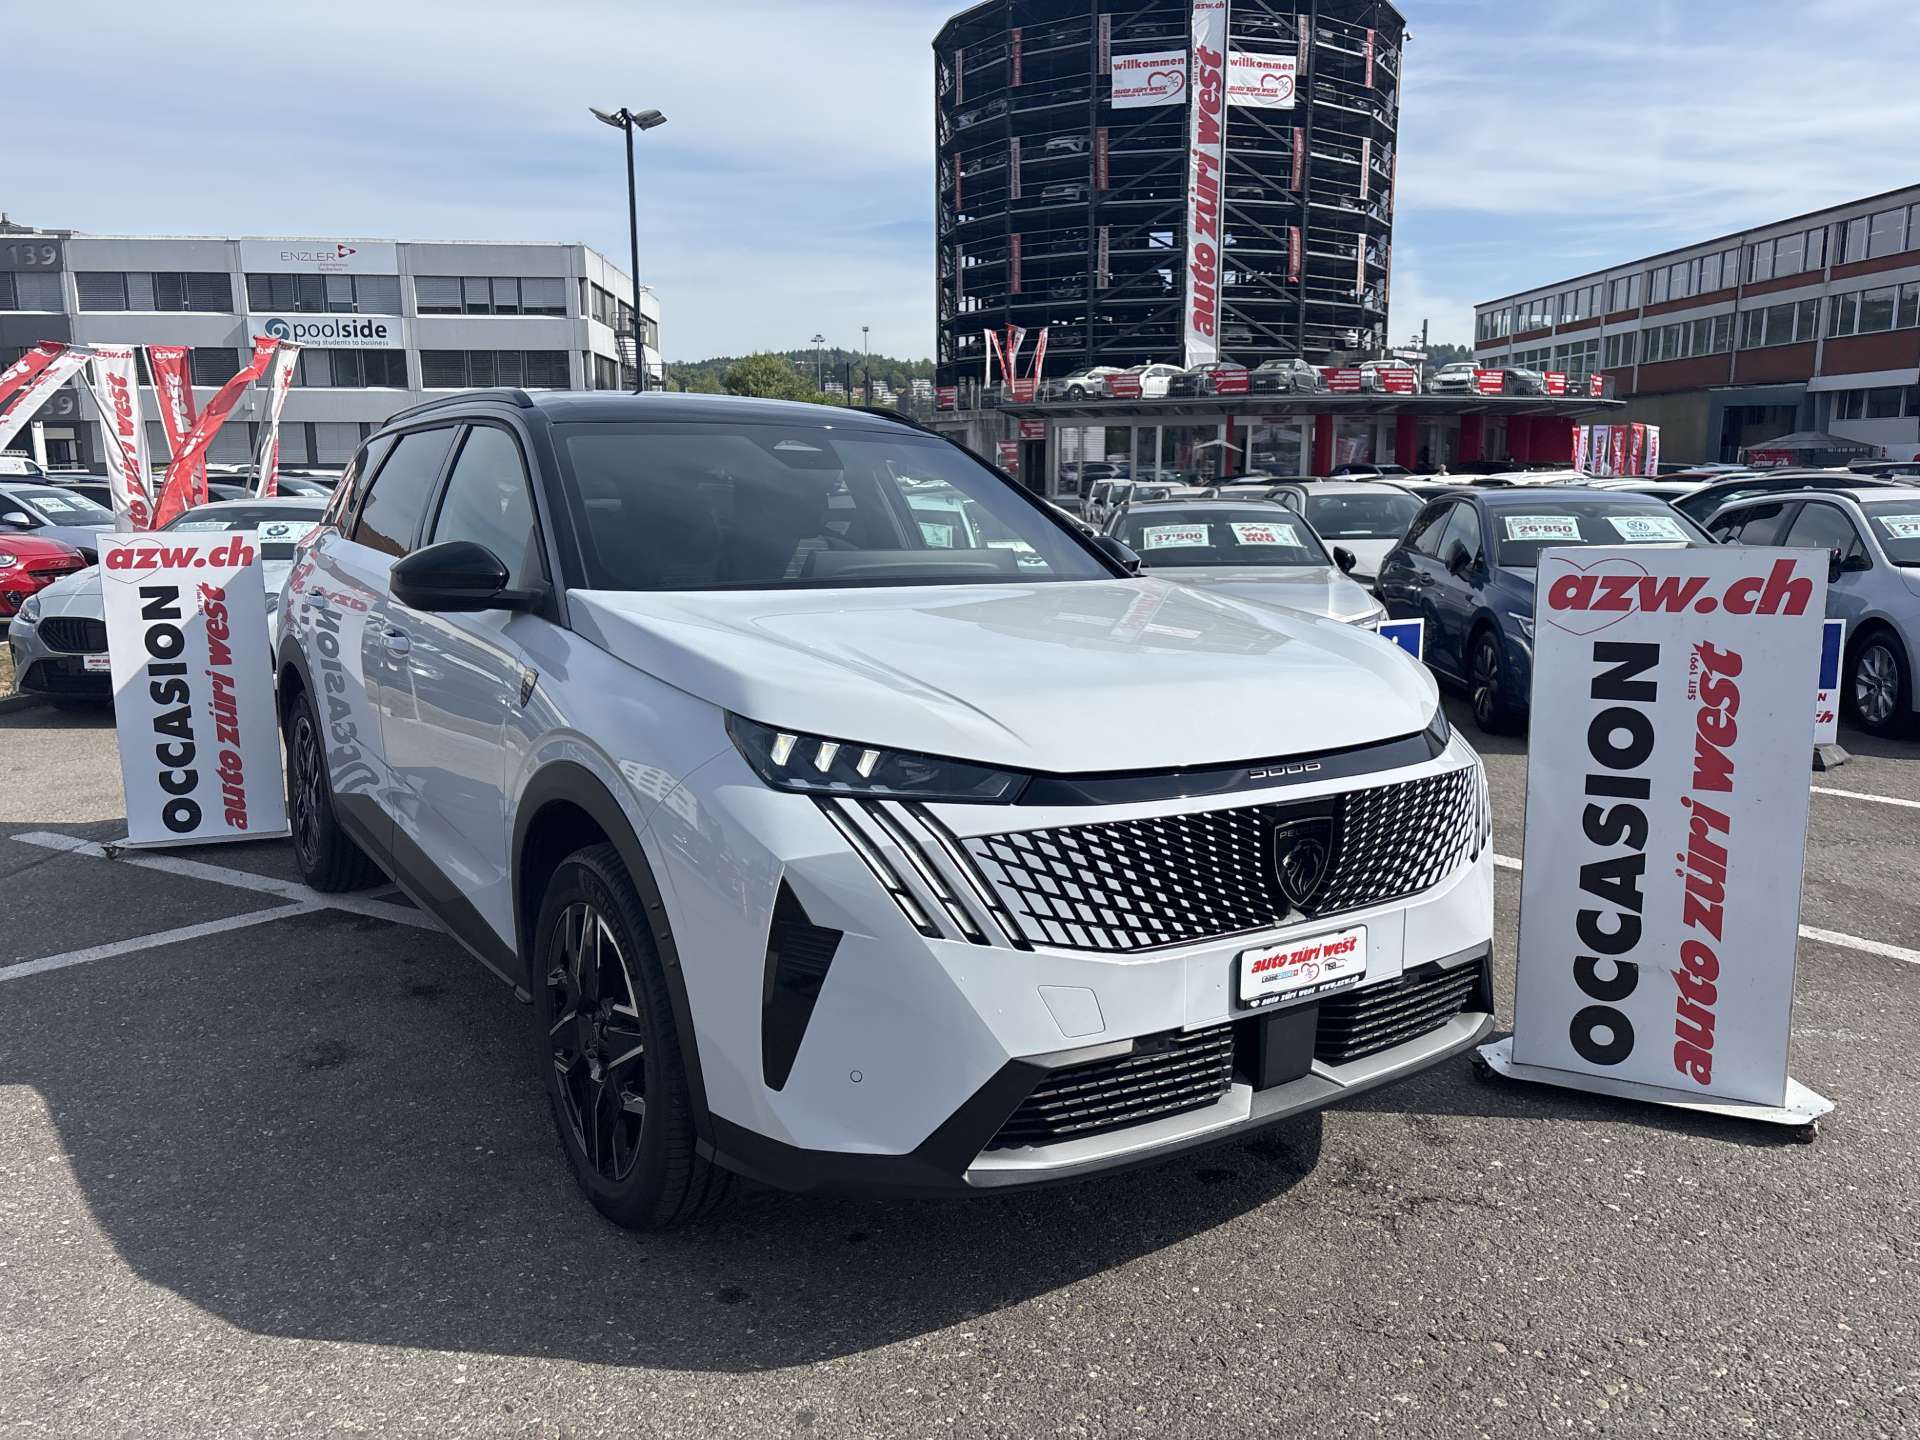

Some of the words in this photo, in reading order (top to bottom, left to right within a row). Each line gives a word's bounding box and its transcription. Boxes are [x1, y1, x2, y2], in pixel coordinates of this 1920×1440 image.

[1113, 57, 1185, 71] willkommen
[1229, 58, 1295, 71] willkommen
[1196, 45, 1222, 144] west
[1189, 150, 1219, 242] züri
[7, 244, 57, 265] 139
[280, 251, 336, 262] ENZLER
[1190, 243, 1217, 337] auto
[293, 318, 387, 342] poolside
[322, 338, 351, 346] students
[107, 371, 135, 437] west
[105, 535, 255, 570] azw.ch
[1153, 532, 1203, 542] 37'500
[1519, 525, 1573, 533] 26'850
[1547, 558, 1813, 617] azw.ch
[195, 581, 233, 666] west
[1690, 652, 1699, 676] 1991
[138, 585, 203, 834] OCCASION
[205, 670, 241, 749] züri
[1687, 680, 1697, 701] SEIT
[1692, 640, 1744, 793] west
[216, 750, 249, 831] auto
[1569, 641, 1661, 1066] OCCASION
[1674, 795, 1731, 944] züri
[1251, 953, 1288, 974] auto
[1288, 943, 1323, 966] züri
[1323, 937, 1358, 958] west
[1261, 995, 1279, 1007] auto
[1280, 991, 1298, 1003] züri
[1299, 986, 1316, 997] west
[1319, 974, 1360, 992] www.azw.ch
[1669, 939, 1720, 1086] auto
